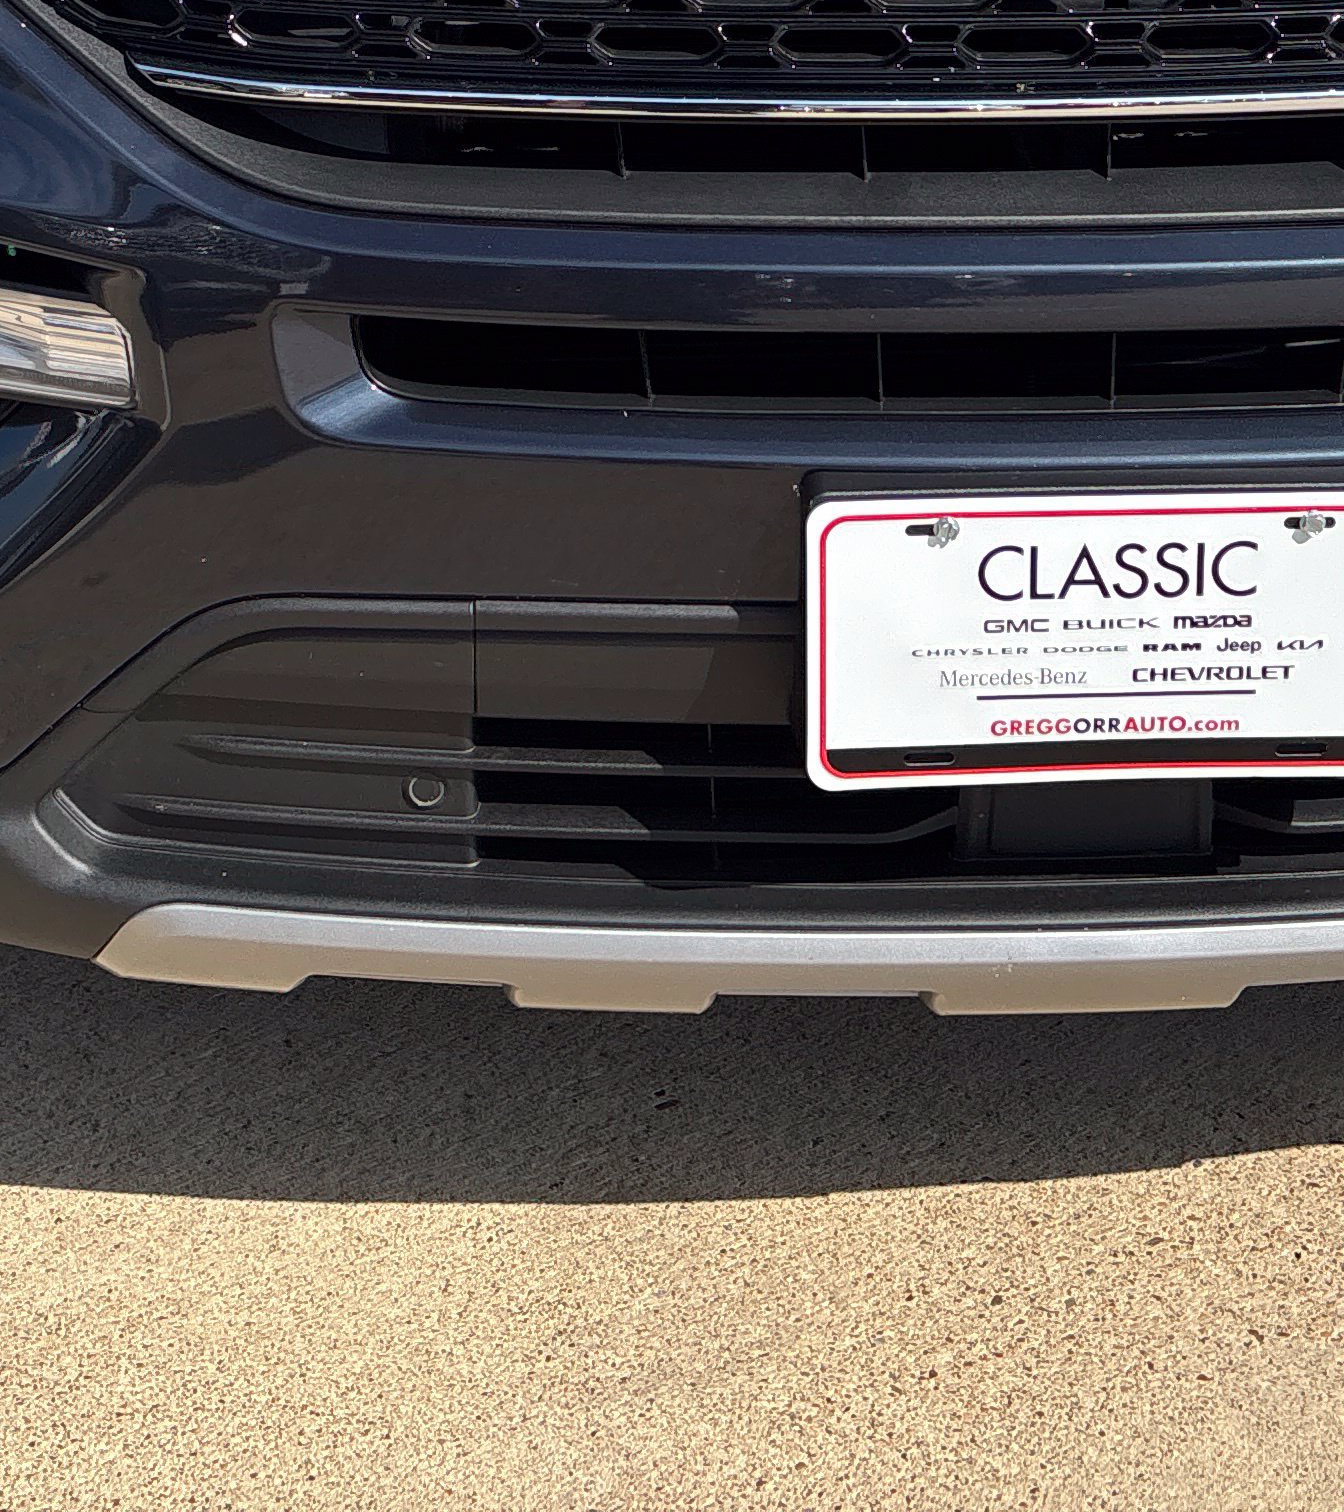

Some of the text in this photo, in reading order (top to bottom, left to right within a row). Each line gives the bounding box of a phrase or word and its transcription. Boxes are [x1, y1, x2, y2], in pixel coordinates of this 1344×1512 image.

[977, 540, 1258, 602] CLASSIC
[983, 618, 1050, 634] GMC
[1063, 617, 1160, 631] BUICK
[911, 646, 1030, 657] CHRYSLER
[1043, 645, 1128, 654] DODGE
[1142, 641, 1202, 653] RAM
[1216, 637, 1262, 655] Jeep
[939, 664, 1296, 688] Mercedes-Benz CHEVROLET
[990, 716, 1240, 737] GREGGORRAUTO.com
